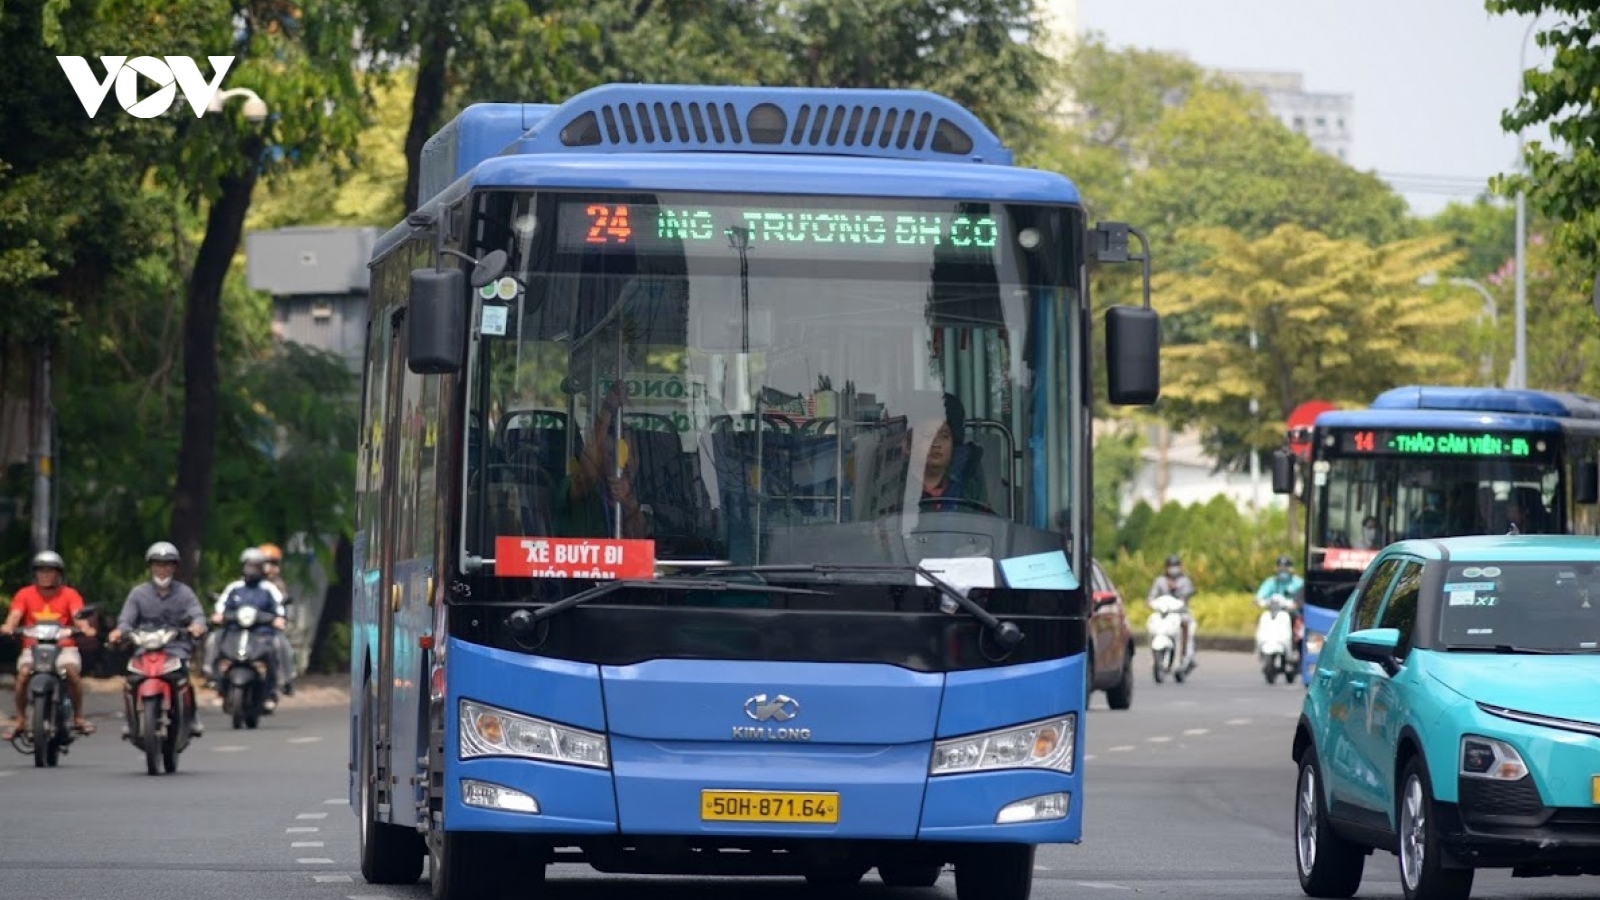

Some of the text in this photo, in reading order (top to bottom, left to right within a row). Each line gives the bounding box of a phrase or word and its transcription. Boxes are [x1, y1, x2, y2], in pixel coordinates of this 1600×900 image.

[586, 205, 631, 243] 24
[1355, 431, 1374, 451] 14
[1469, 434, 1502, 455] VIÊN
[555, 542, 600, 564] BUÝT
[604, 545, 623, 565] ĐI
[732, 726, 811, 740] KIM LONG
[713, 797, 826, 817] 50H-871.64
